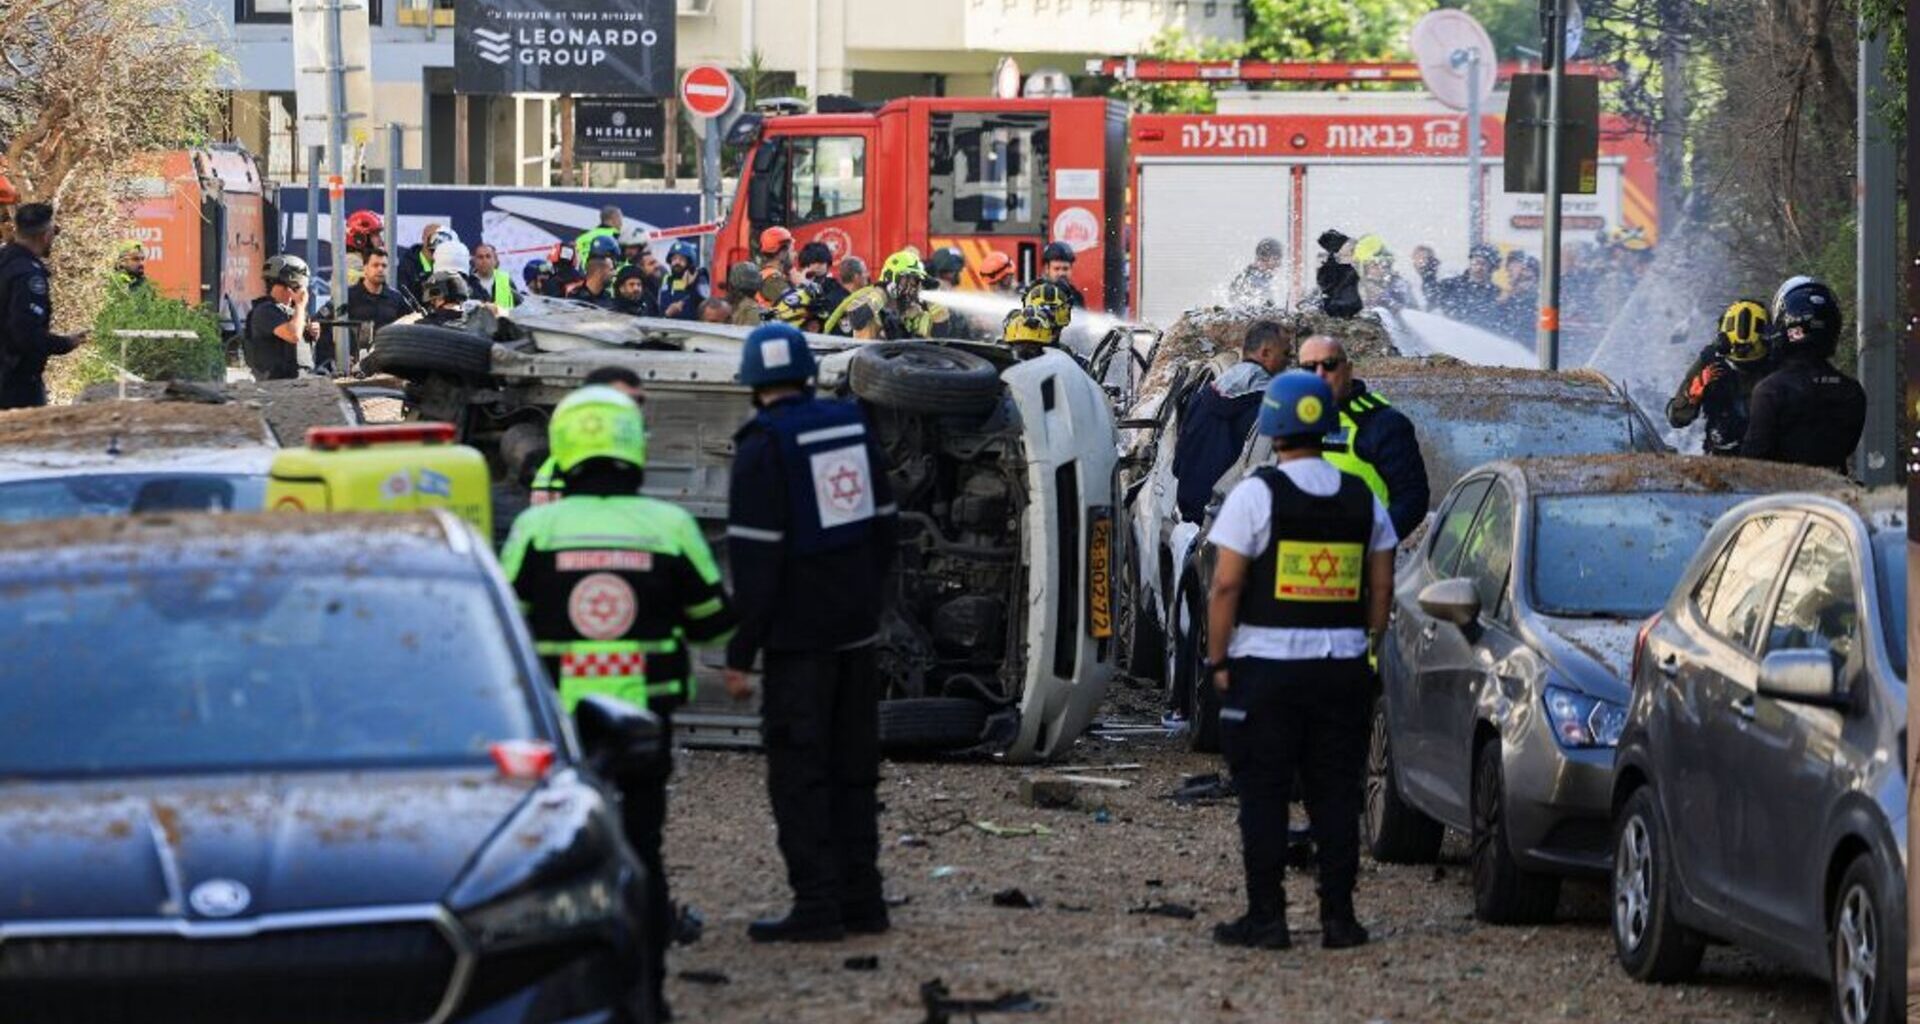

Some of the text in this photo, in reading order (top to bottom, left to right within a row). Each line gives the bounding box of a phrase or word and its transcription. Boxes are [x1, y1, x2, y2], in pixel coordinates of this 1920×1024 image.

[519, 28, 658, 46] LEONARDO
[519, 49, 606, 66] GROUP
[585, 126, 653, 138] SHEMESH
[1181, 119, 1268, 148] והצלה
[1325, 123, 1414, 149] כבאות
